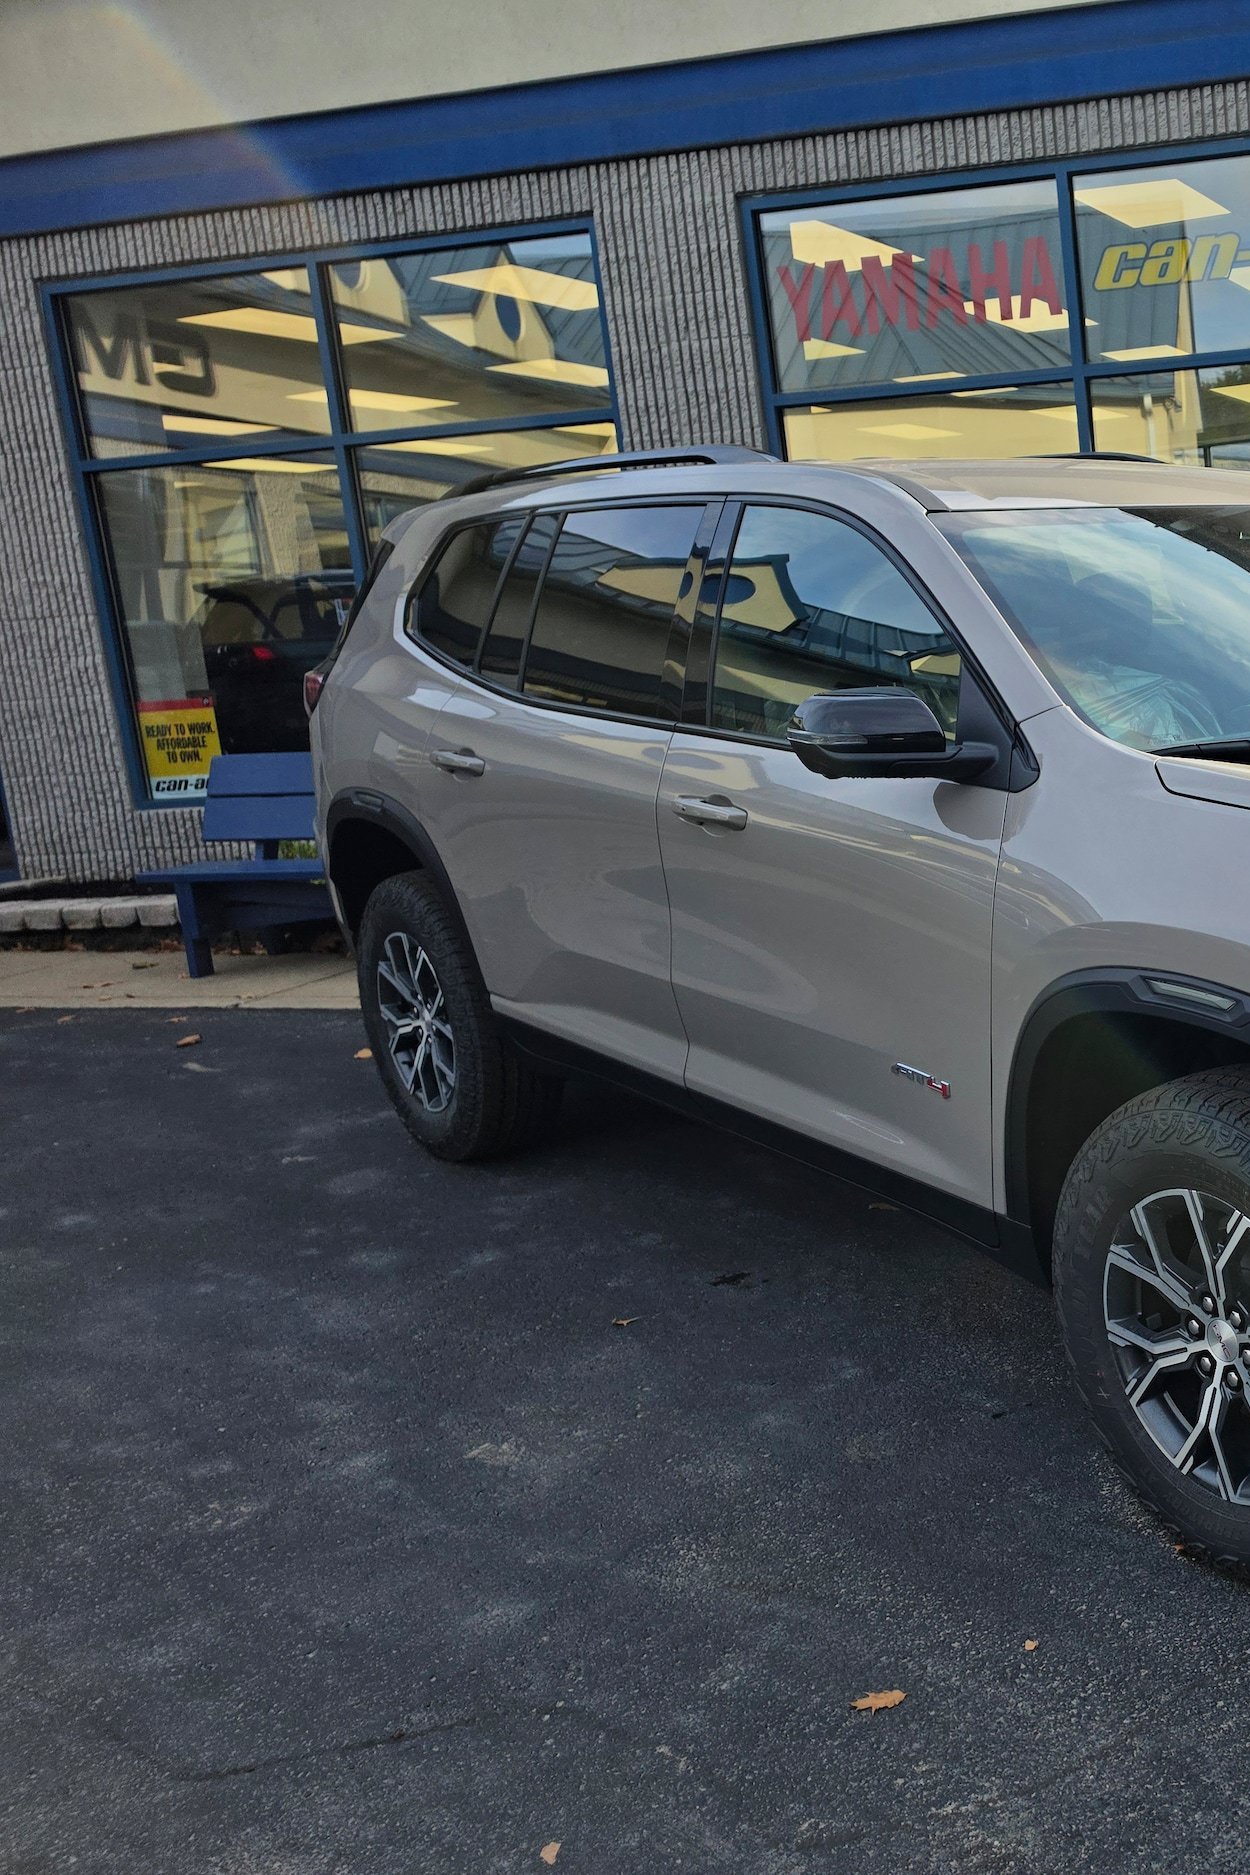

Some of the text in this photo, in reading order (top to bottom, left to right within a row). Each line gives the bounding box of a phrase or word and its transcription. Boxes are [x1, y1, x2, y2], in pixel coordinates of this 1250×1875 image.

[776, 236, 1063, 342] YAMAHA
[145, 721, 215, 738] READY TO WORK.
[157, 736, 207, 751] AFFORDABLE
[167, 749, 202, 763] TO OWN.
[155, 778, 209, 792] can-a
[891, 1062, 951, 1099] AT4
